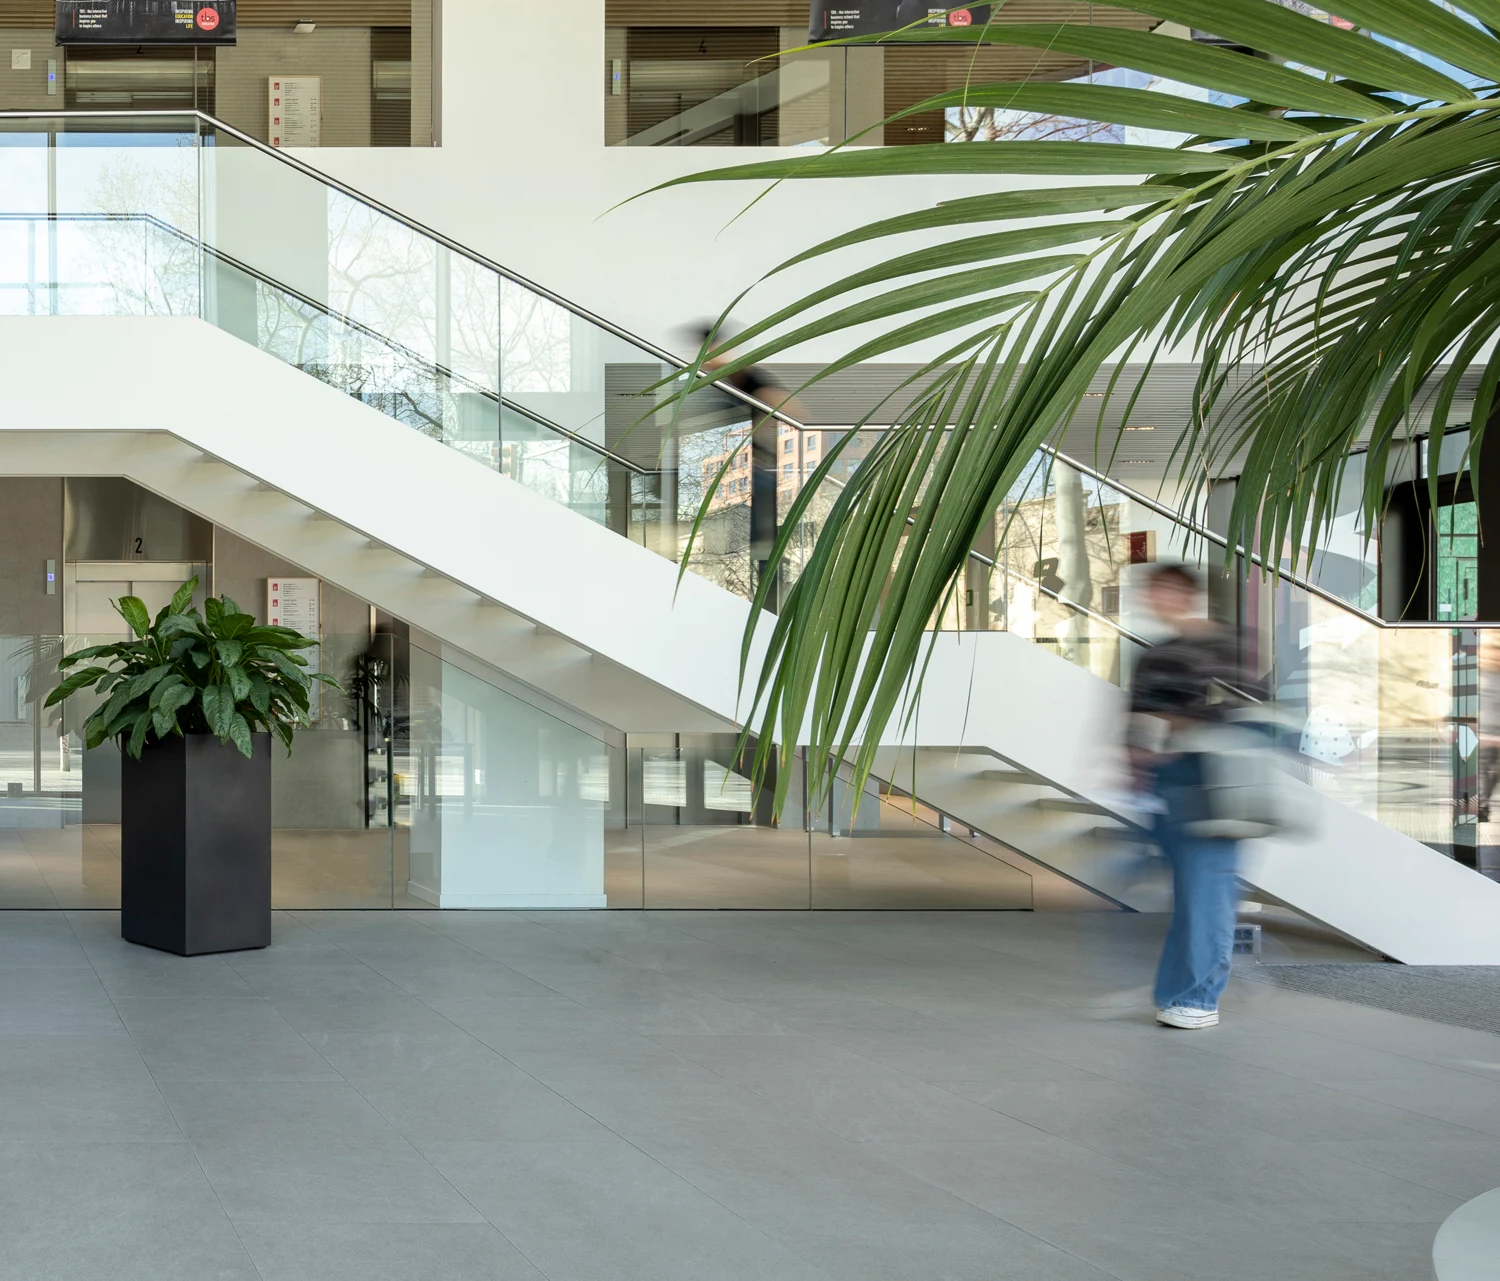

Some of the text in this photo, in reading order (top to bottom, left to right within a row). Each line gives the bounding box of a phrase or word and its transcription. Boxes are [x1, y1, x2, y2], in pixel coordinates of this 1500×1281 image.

[200, 11, 216, 22] tbs
[953, 11, 968, 22] tbs
[135, 537, 143, 554] 2
